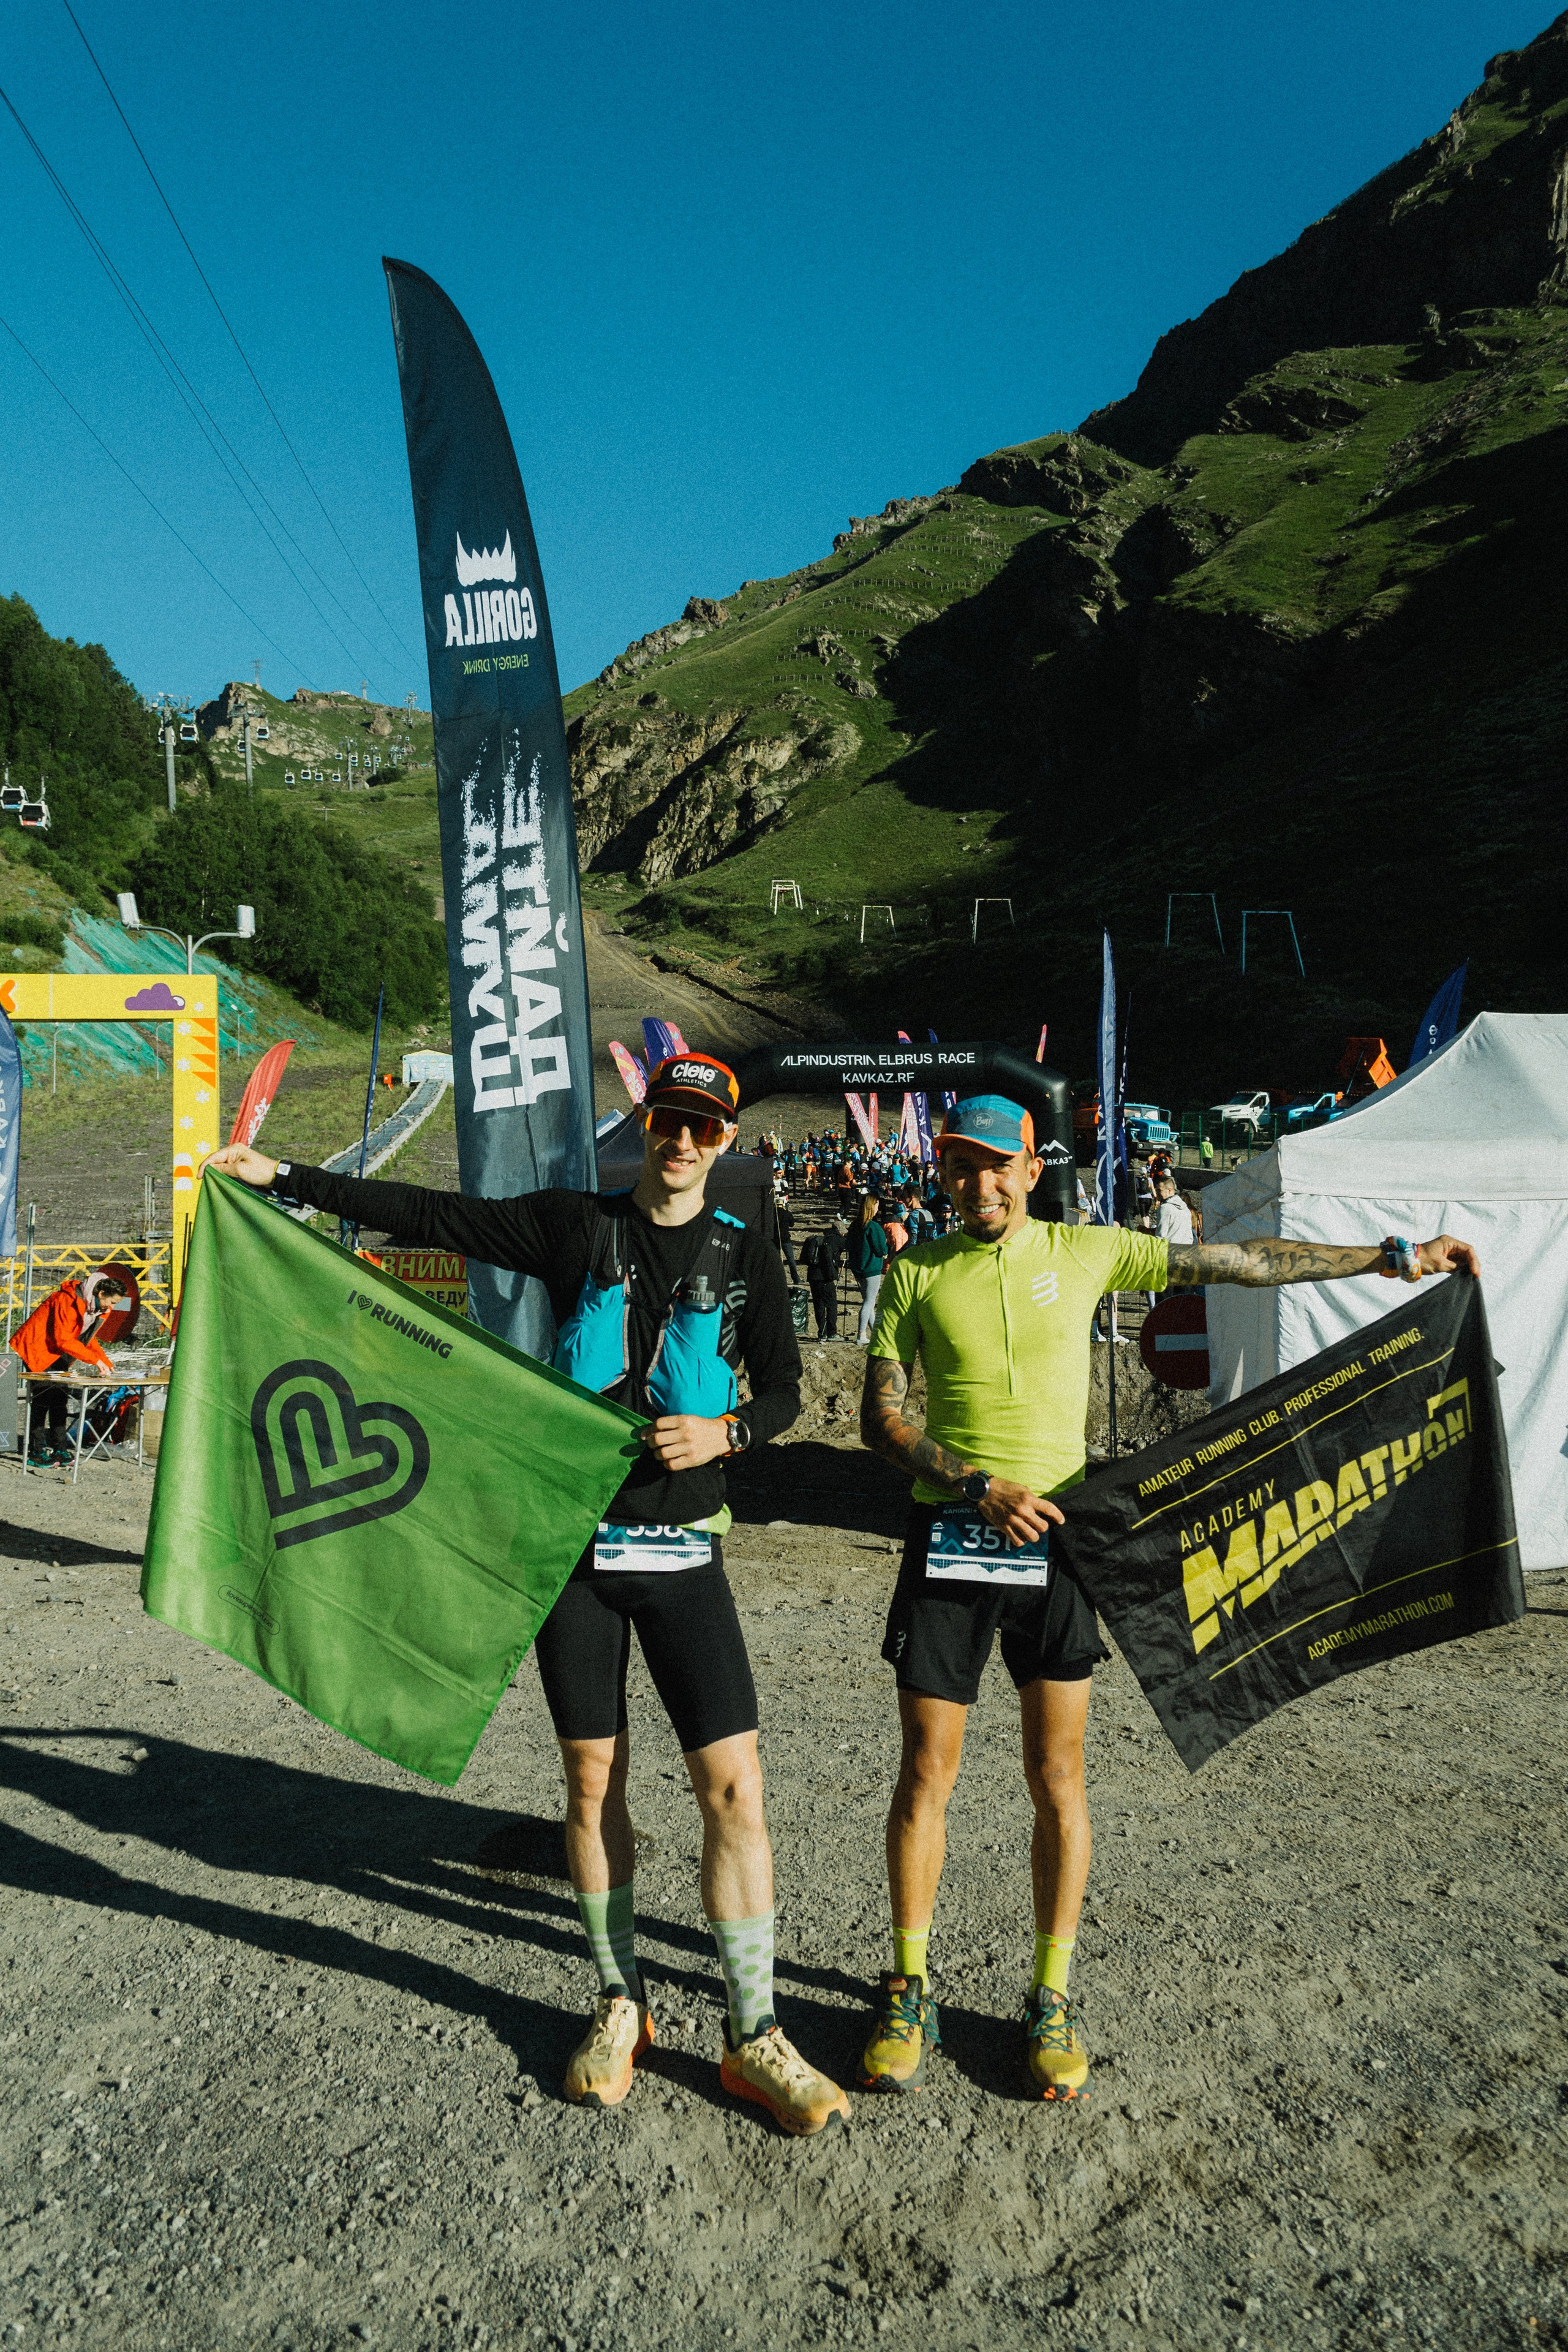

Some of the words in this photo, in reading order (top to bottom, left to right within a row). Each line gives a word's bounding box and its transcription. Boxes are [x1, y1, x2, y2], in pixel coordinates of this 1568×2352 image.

[780, 1055, 876, 1066] ALPINDUSTRIA
[879, 1053, 933, 1066] ELBRUS
[938, 1052, 976, 1064] RACE
[842, 1072, 915, 1084] KAVKAZ.RF
[676, 1078, 707, 1088] ATHLETICS
[1042, 1157, 1069, 1166] АВКАЗ
[381, 1256, 467, 1279] ВНИМ
[347, 1289, 358, 1305] I
[370, 1303, 454, 1359] RUNNING
[1139, 1458, 1195, 1497] AMATEUR
[1196, 1429, 1247, 1465] RUNNING
[1249, 1409, 1284, 1436] CLUB.
[1284, 1360, 1366, 1415] PROFESSIONAL
[1368, 1327, 1425, 1366] TRAINING.
[1180, 1479, 1276, 1552] ACADEMY
[1182, 1408, 1466, 1655] MARATHON
[1308, 1592, 1455, 1660] ACADEMYMARATHON.COM
